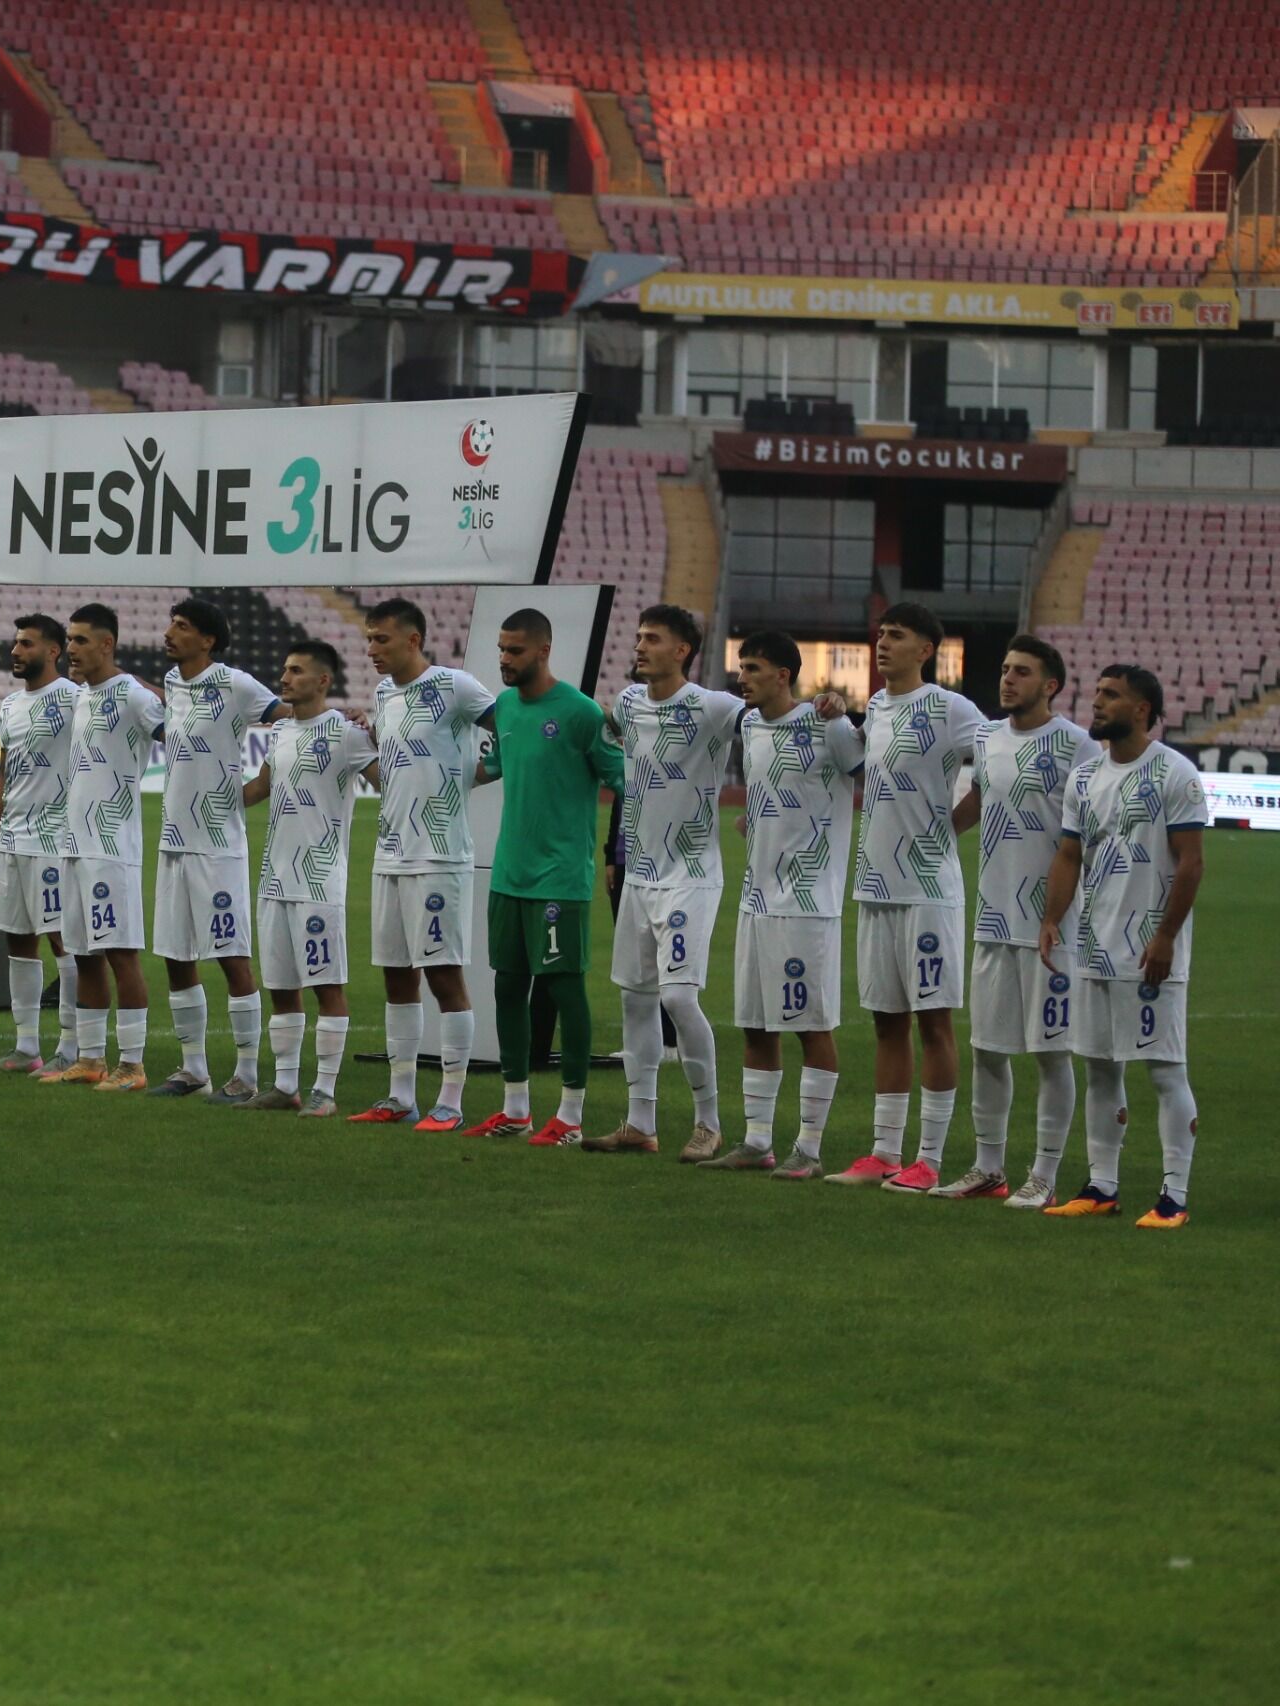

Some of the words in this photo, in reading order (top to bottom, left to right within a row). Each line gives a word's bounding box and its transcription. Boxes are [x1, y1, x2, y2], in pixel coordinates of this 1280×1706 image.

[648, 282, 795, 310] MUTLULUK
[755, 439, 1024, 471] #BizimÇocuklar
[1227, 794, 1280, 809] MASS
[41, 888, 62, 912] 11
[91, 903, 116, 930] 54
[210, 913, 235, 938] 42
[428, 916, 443, 942] 4
[305, 938, 331, 966] 21
[547, 926, 559, 953] 1
[671, 934, 686, 963] 8
[918, 957, 943, 988] 17
[782, 981, 807, 1011] 19
[1043, 996, 1069, 1027] 61
[1140, 1005, 1155, 1037] 9
